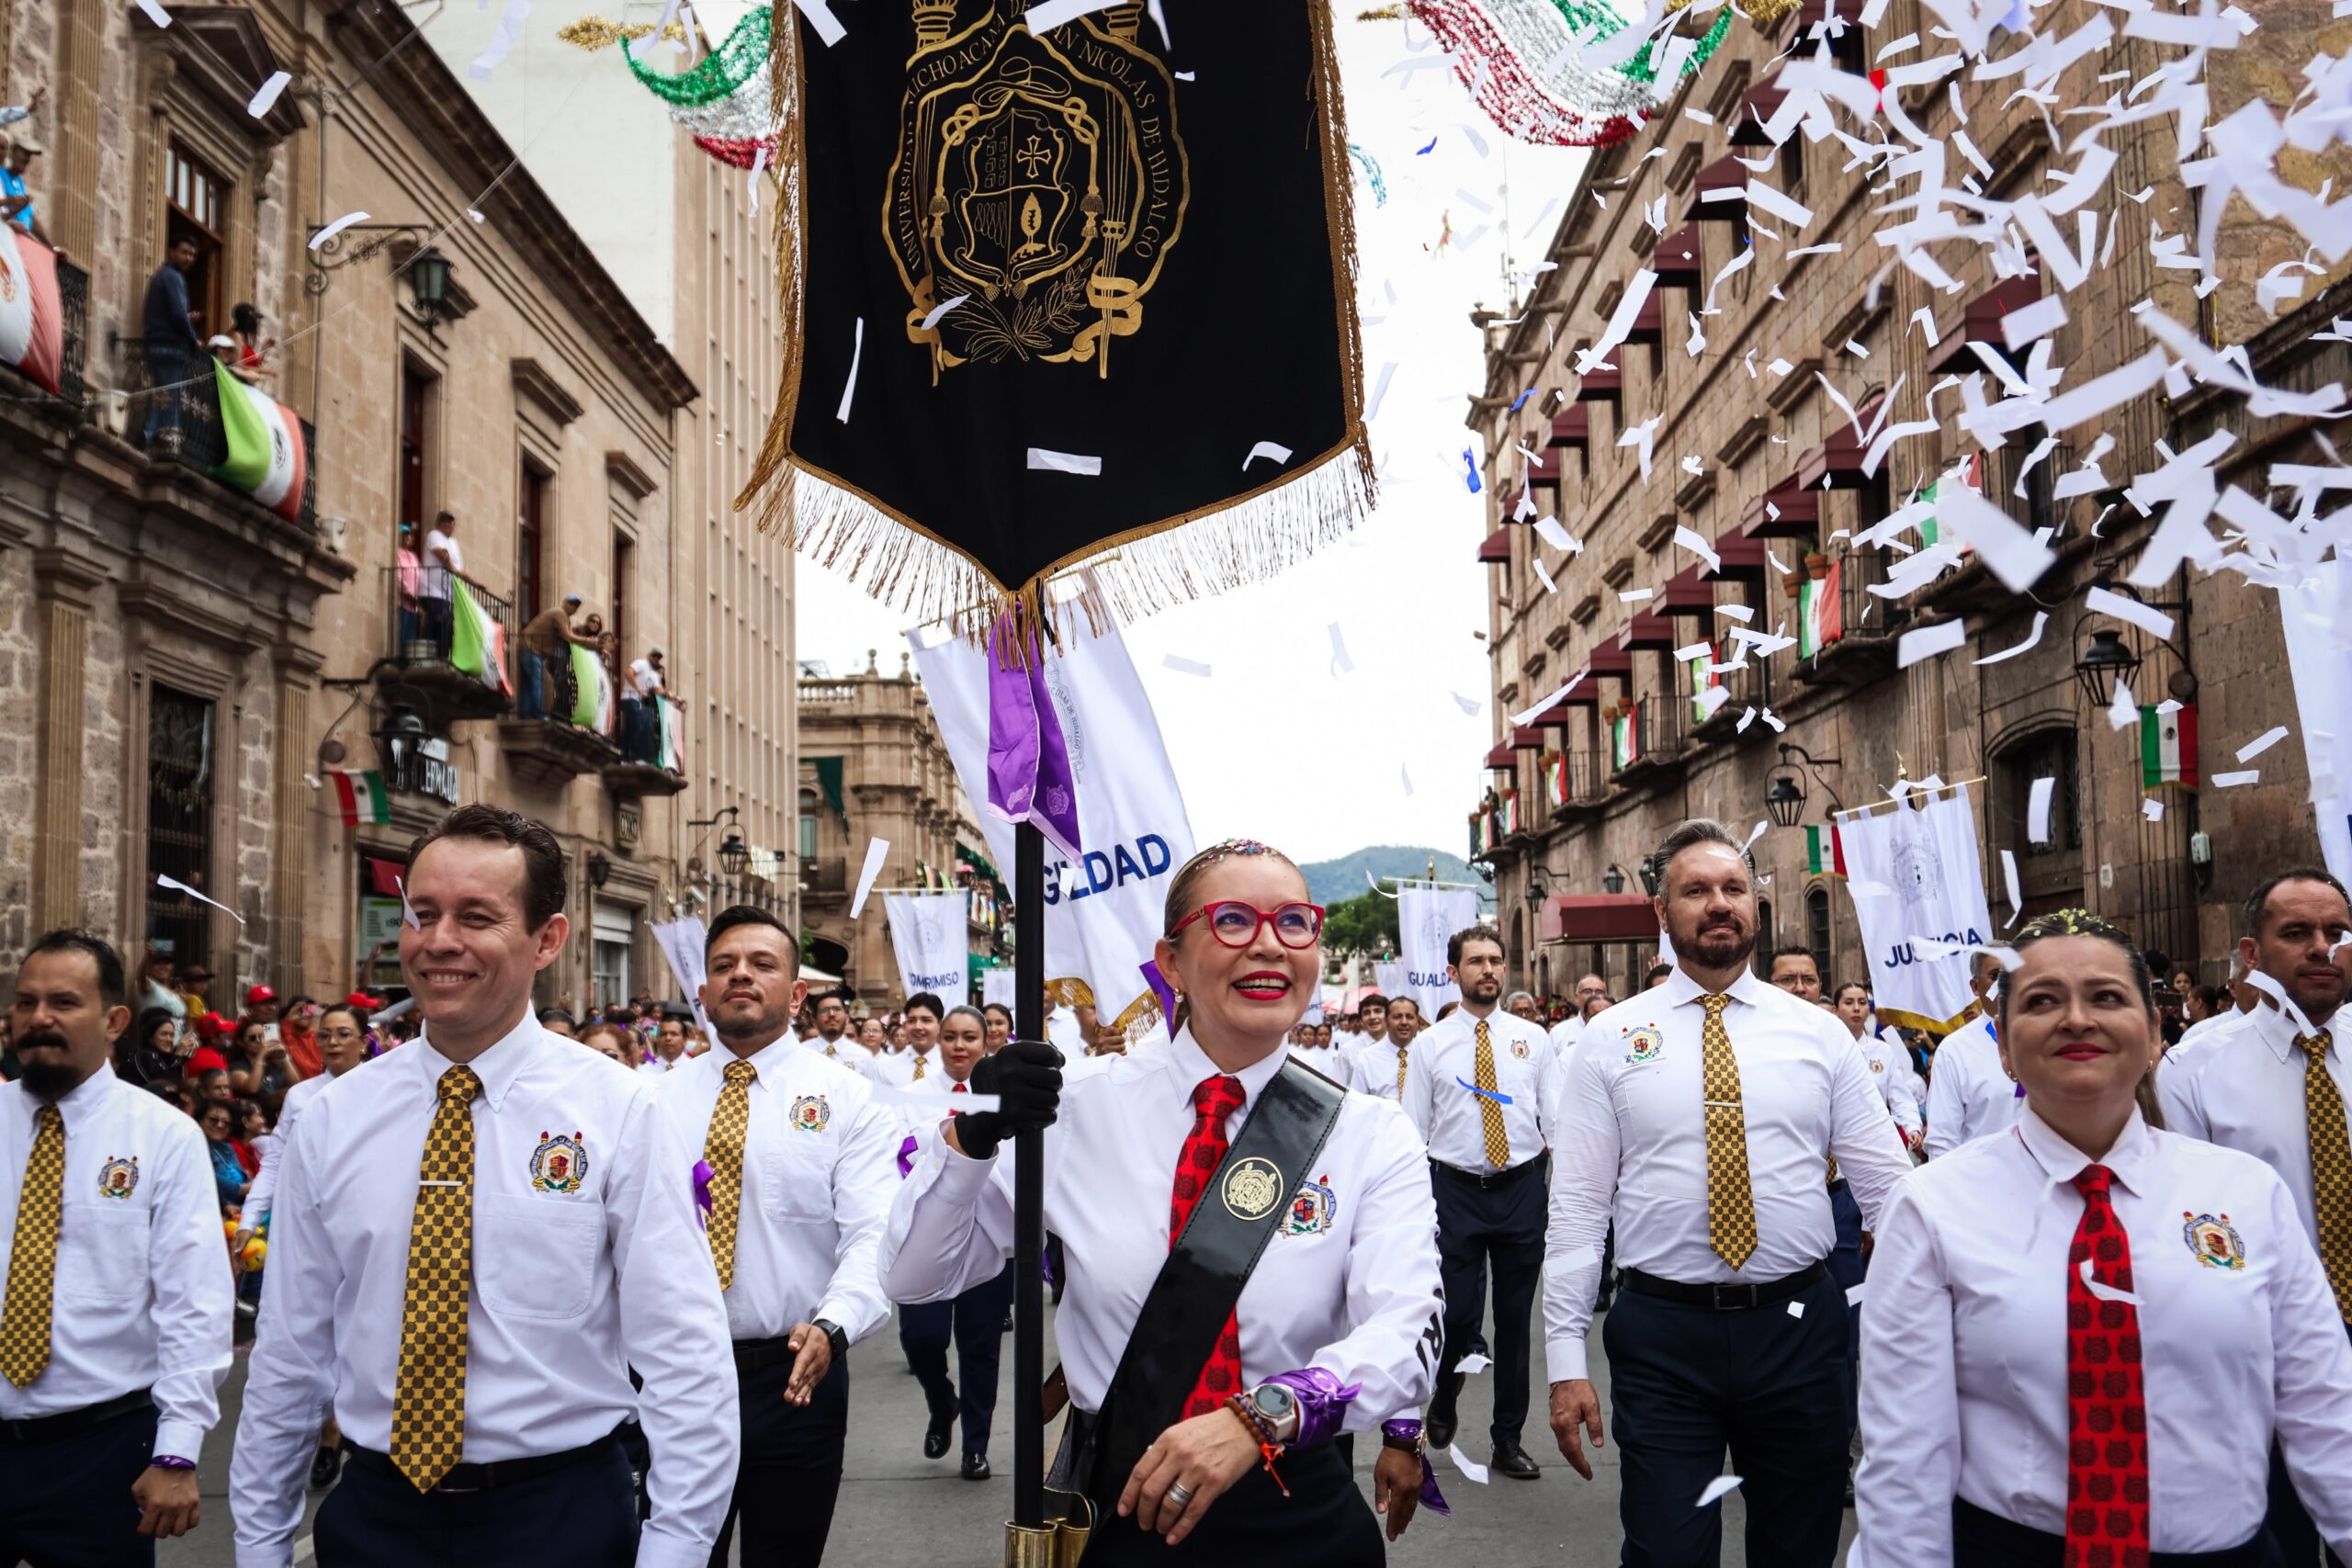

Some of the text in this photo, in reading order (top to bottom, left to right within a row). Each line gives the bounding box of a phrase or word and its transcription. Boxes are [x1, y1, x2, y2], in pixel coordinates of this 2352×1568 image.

[1079, 39, 1155, 109] NICOLAS
[1141, 116, 1161, 147] DE
[1135, 150, 1170, 258] HIDALGO
